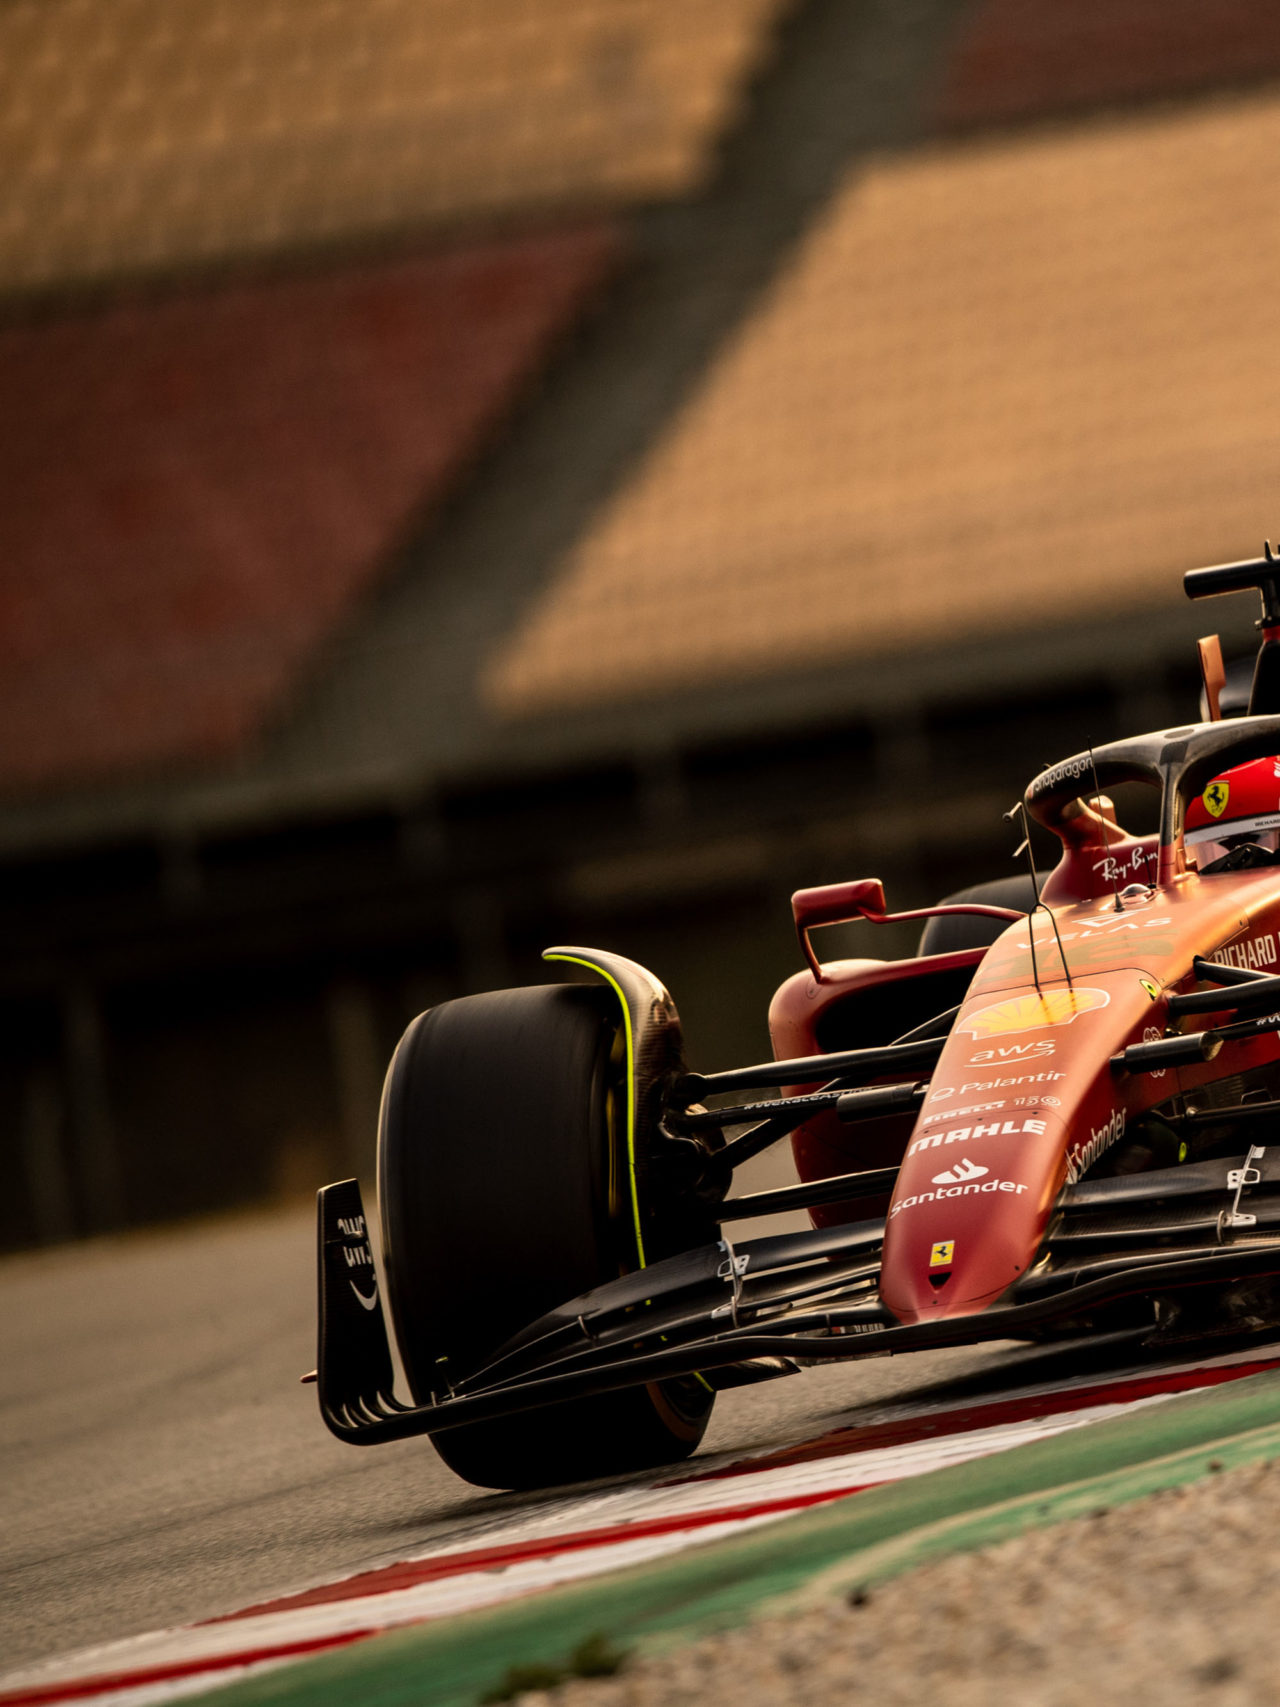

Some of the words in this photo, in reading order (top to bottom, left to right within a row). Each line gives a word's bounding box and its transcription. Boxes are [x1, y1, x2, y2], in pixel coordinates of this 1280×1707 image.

[1092, 846, 1158, 881] Ray-Ban
[1016, 917, 1172, 949] VELAS
[970, 1039, 1056, 1063] aws
[959, 1071, 1067, 1095] Palantir
[907, 1119, 1048, 1158] MAHLE
[1074, 1107, 1127, 1181] Santander
[889, 1179, 1029, 1220] Santander
